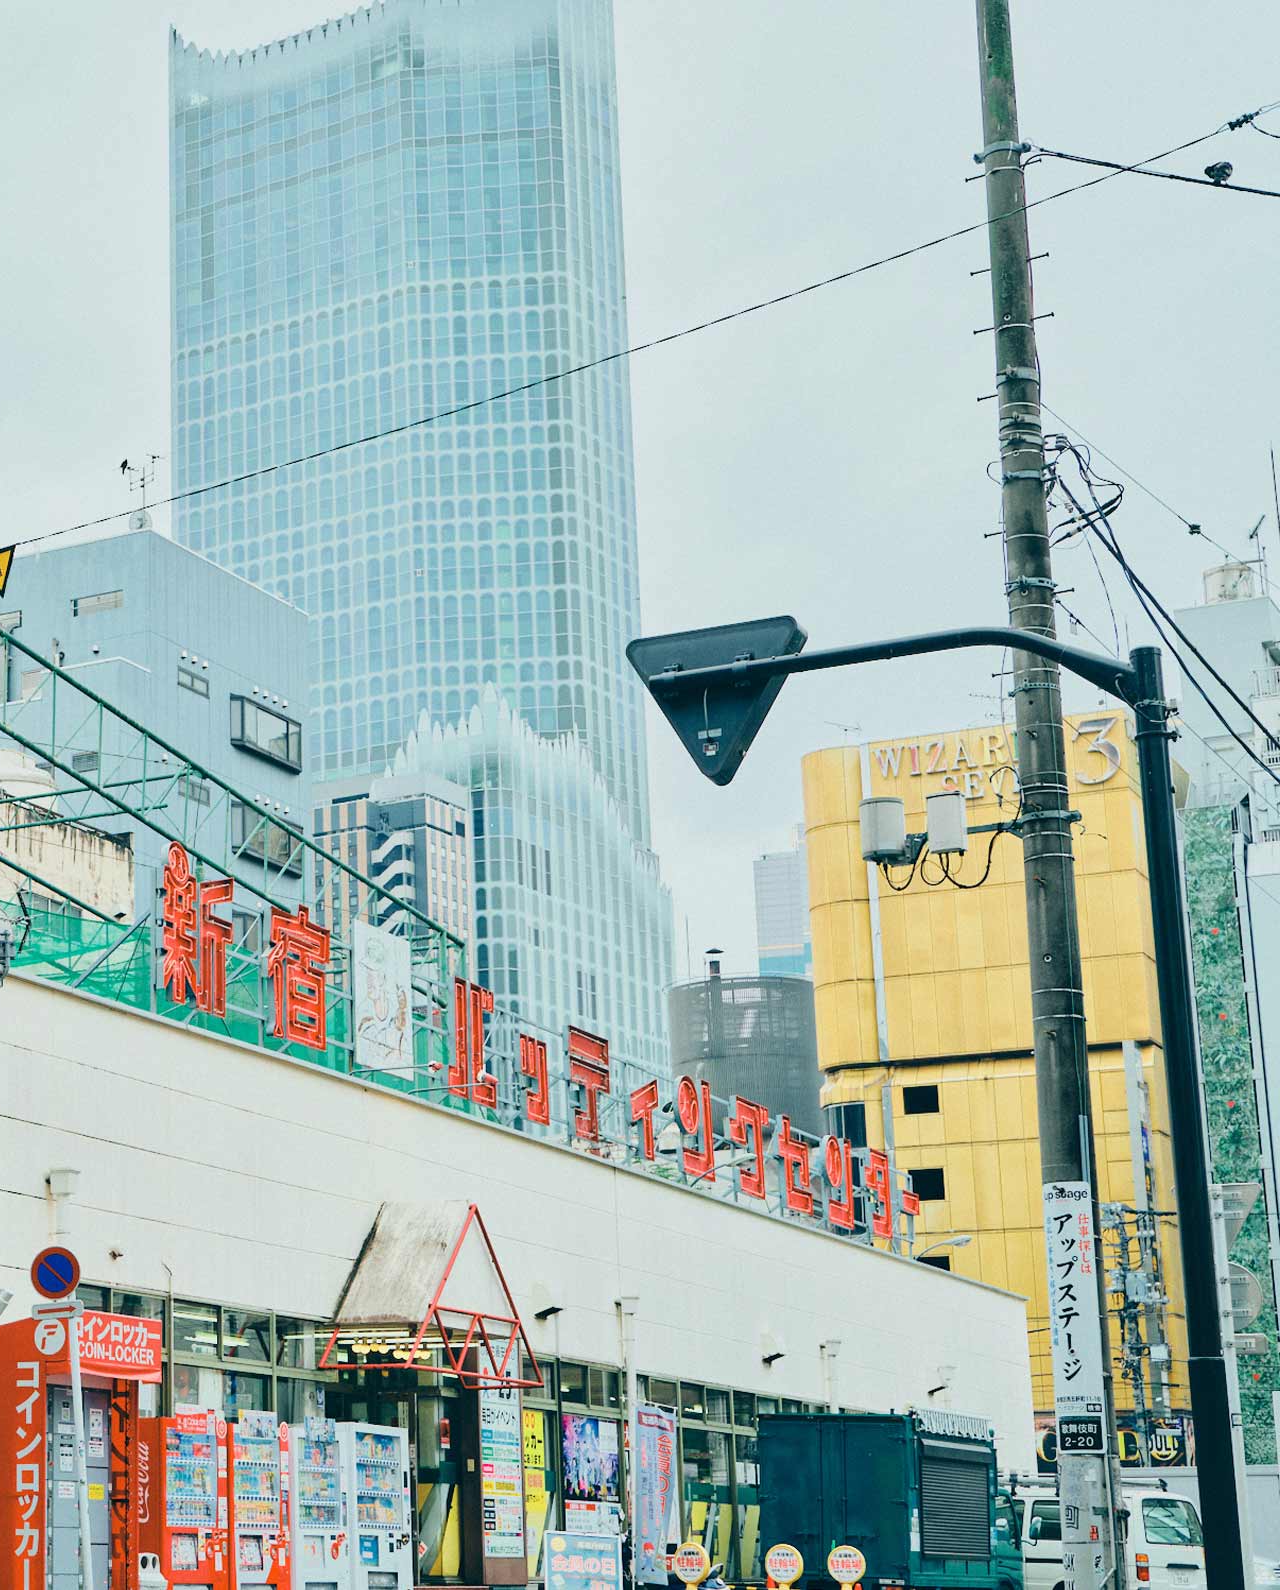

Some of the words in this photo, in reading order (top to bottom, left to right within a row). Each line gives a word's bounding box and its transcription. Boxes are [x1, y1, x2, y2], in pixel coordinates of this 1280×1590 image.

[163, 841, 331, 1052] 新宿
[448, 977, 920, 1239] バッティングセンター
[1053, 1213, 1082, 1382] アップステージ
[78, 1341, 155, 1365] COIN-LOCKER
[15, 1361, 41, 1590] コインロッカー
[1061, 1423, 1097, 1435] 歌舞伎町
[1065, 1436, 1094, 1447] 2-20
